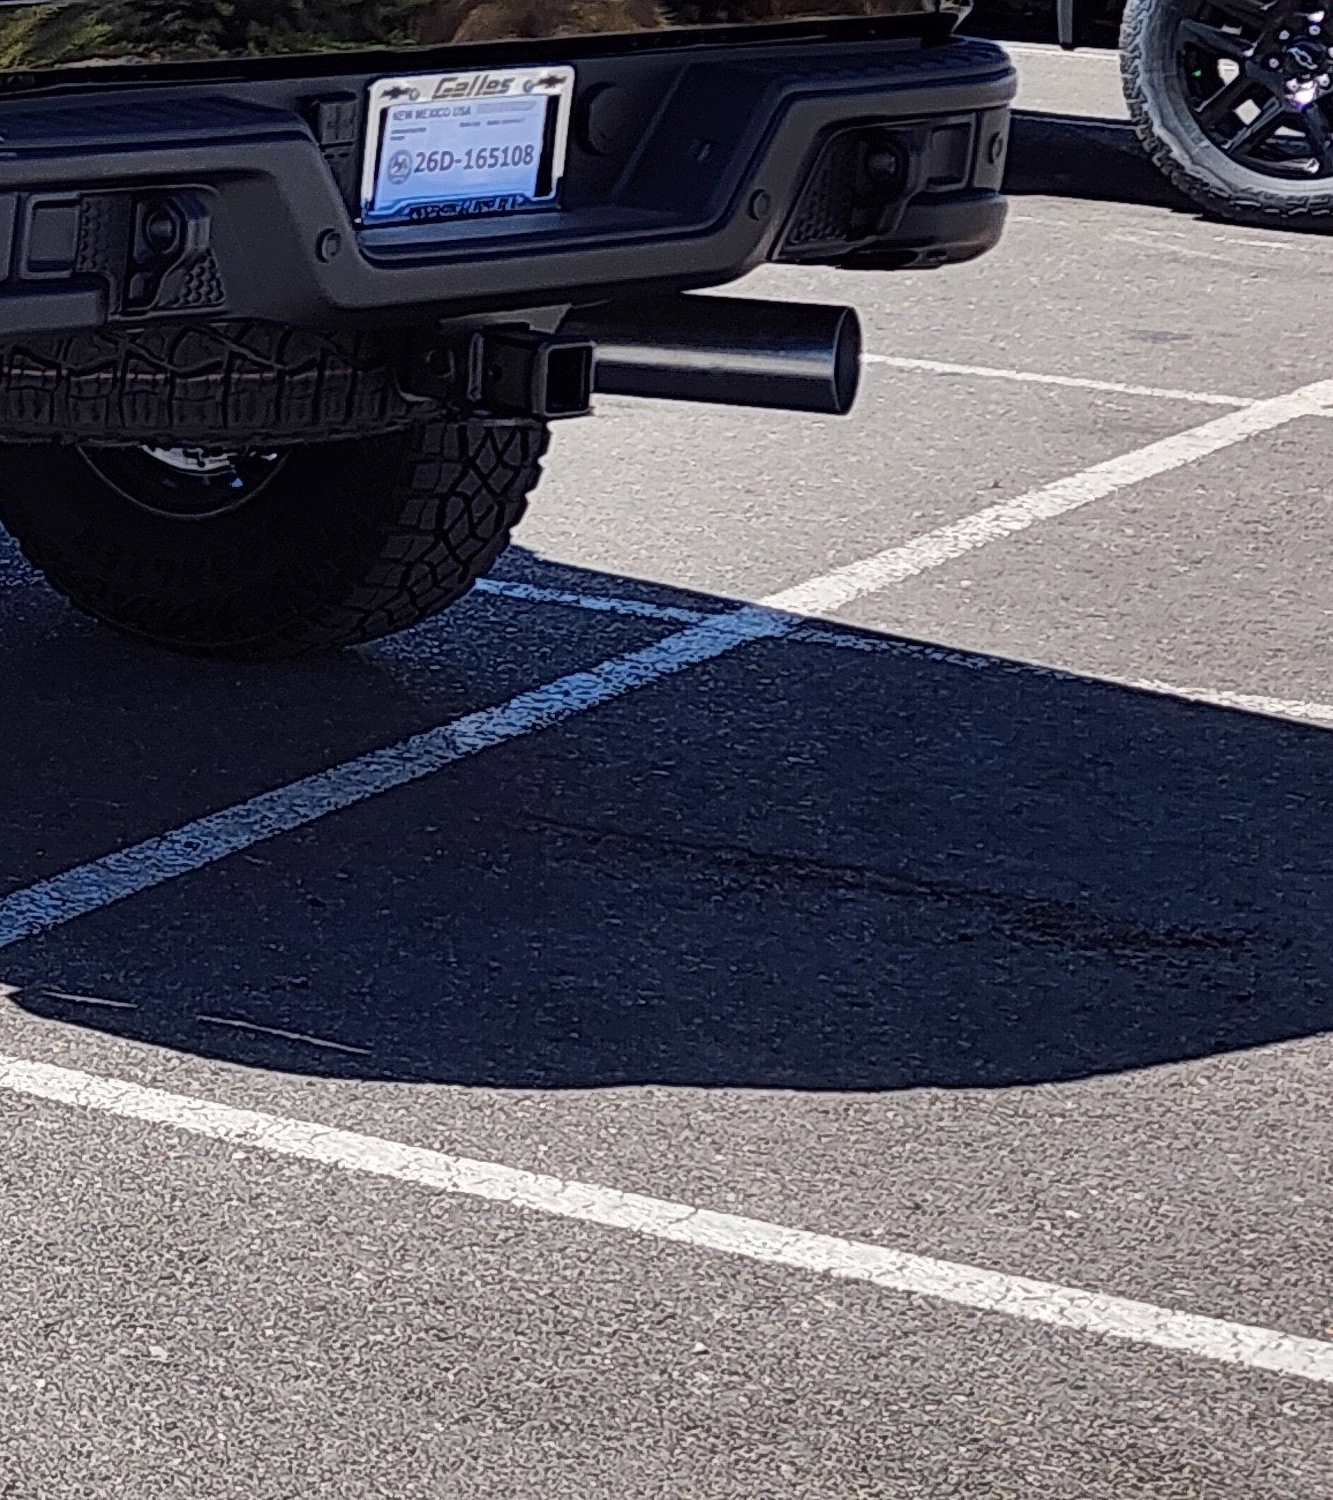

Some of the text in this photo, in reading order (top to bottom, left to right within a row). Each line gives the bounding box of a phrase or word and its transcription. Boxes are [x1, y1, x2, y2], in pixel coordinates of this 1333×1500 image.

[432, 74, 516, 99] Galles
[393, 110, 413, 121] NEW
[415, 107, 450, 119] MEXICO
[414, 144, 535, 173] 26D-165108
